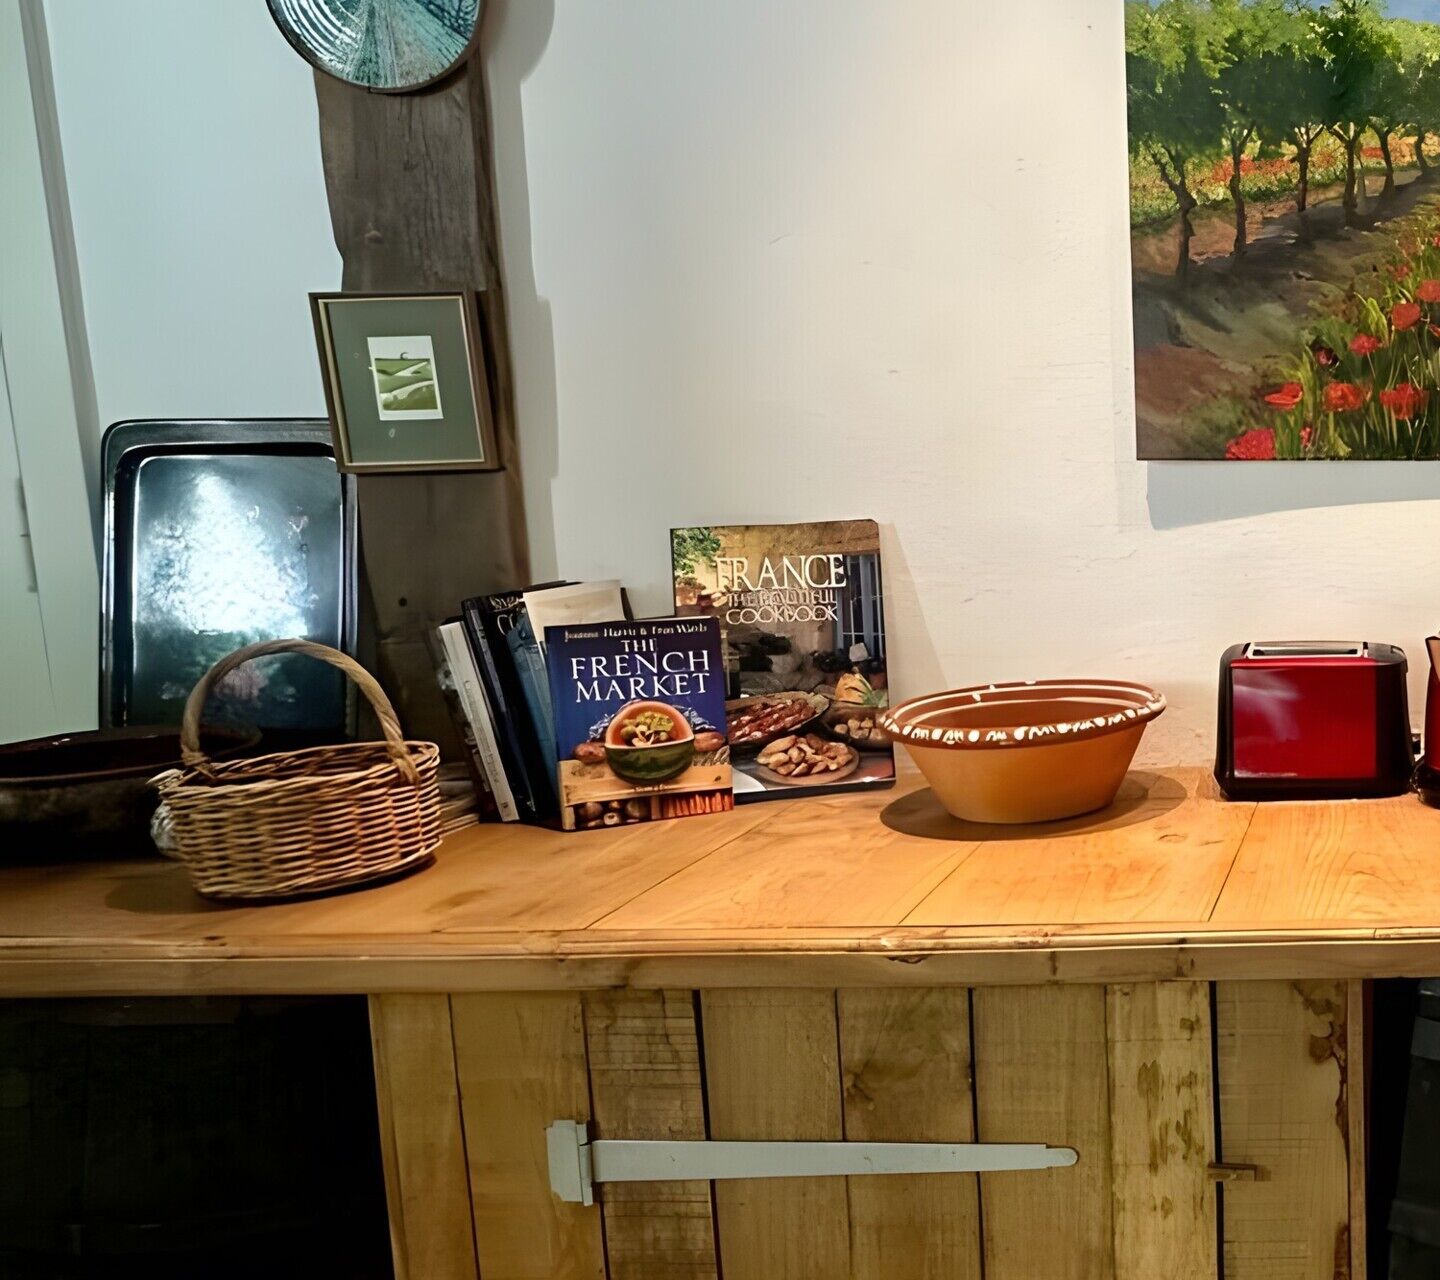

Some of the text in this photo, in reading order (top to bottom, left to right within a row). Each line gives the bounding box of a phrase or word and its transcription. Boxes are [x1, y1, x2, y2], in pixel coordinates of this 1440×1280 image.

[714, 553, 847, 592] FRANCE
[570, 649, 710, 680] FRENCH
[575, 672, 711, 703] MARKET
